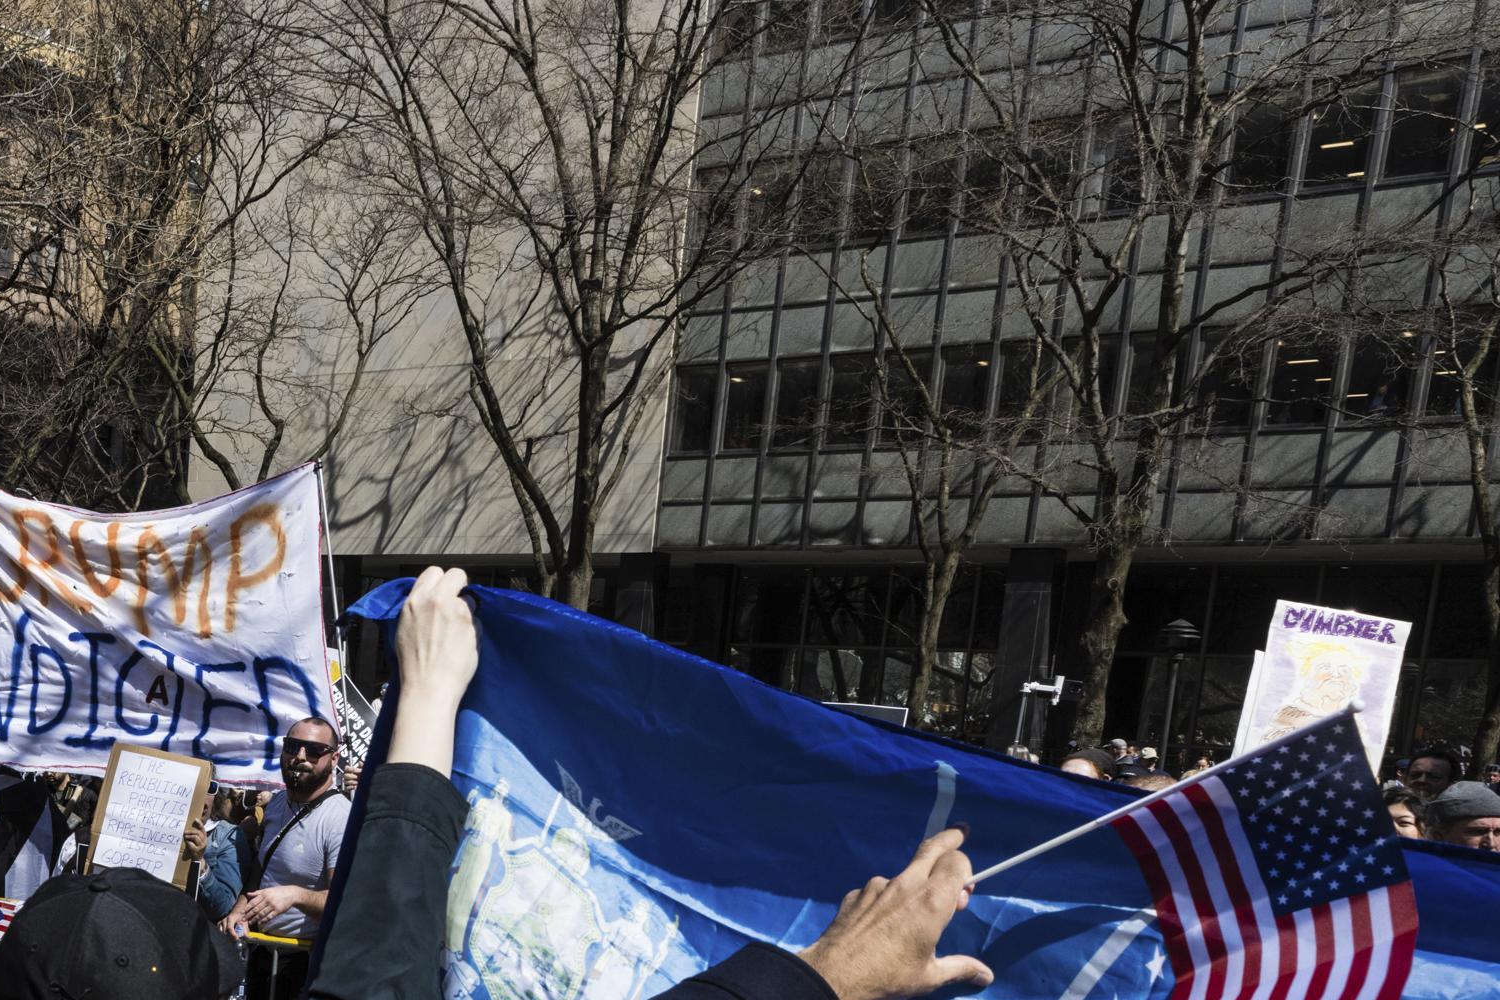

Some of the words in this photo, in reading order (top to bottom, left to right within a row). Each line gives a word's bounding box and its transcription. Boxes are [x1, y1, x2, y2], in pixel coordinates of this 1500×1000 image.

[138, 755, 165, 775] THE
[118, 770, 193, 798] REPUBLICAN
[129, 791, 171, 816] PARTY
[106, 818, 136, 837] RAPE
